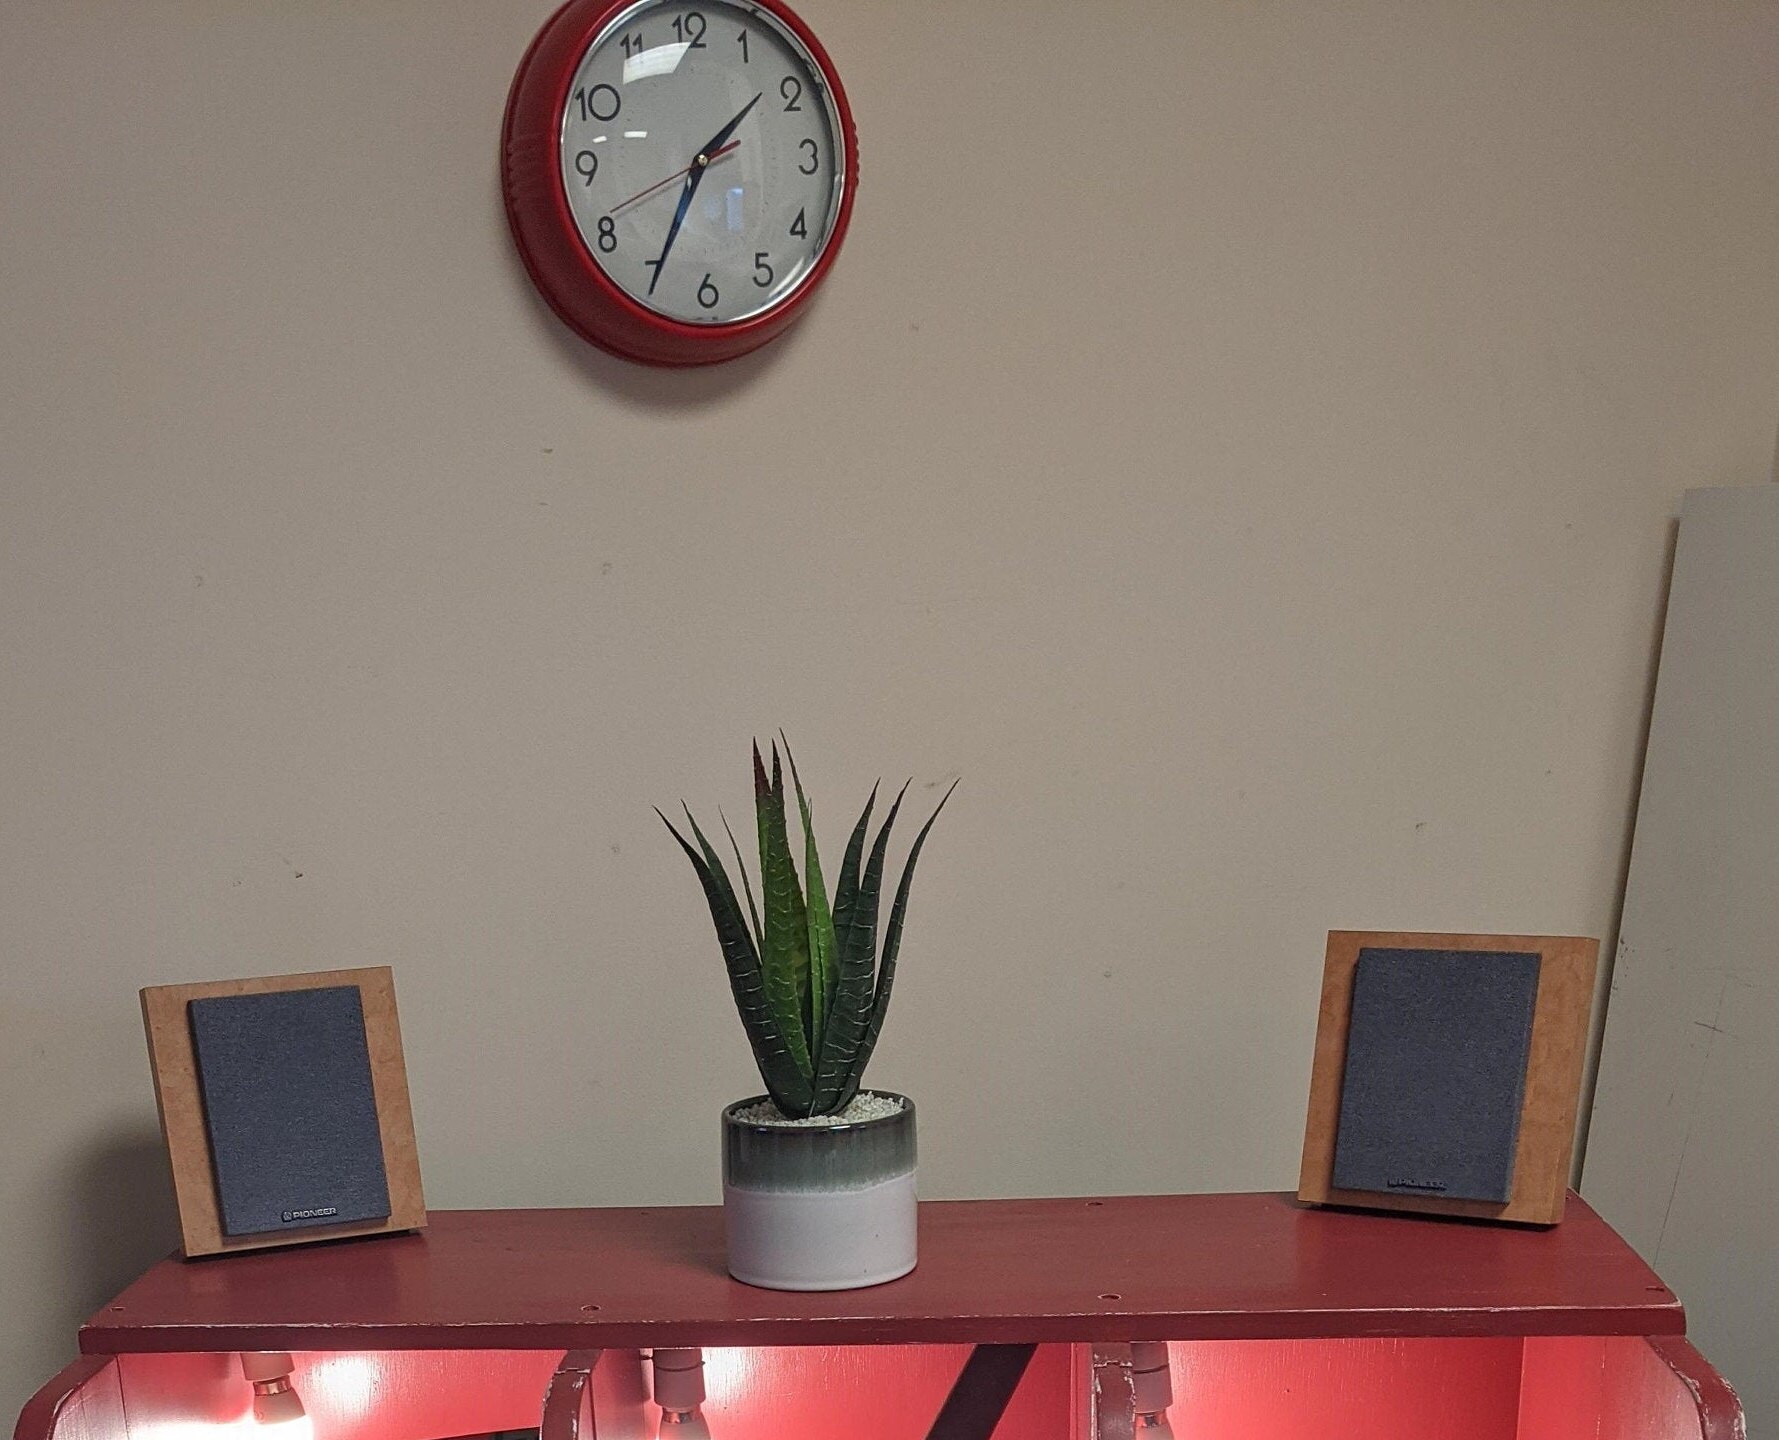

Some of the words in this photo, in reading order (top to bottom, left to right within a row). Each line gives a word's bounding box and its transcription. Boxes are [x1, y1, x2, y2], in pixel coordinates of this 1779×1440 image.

[672, 12, 707, 48] 12
[737, 29, 749, 63] 1
[620, 33, 645, 66] 11
[575, 83, 621, 121] 10
[780, 76, 802, 112] 2
[575, 150, 598, 187] 9
[798, 138, 819, 175] 3
[598, 216, 617, 252] 8
[789, 207, 808, 240] 4
[753, 252, 774, 287] 5
[697, 273, 719, 308] 6
[293, 1207, 337, 1218] PIONEER
